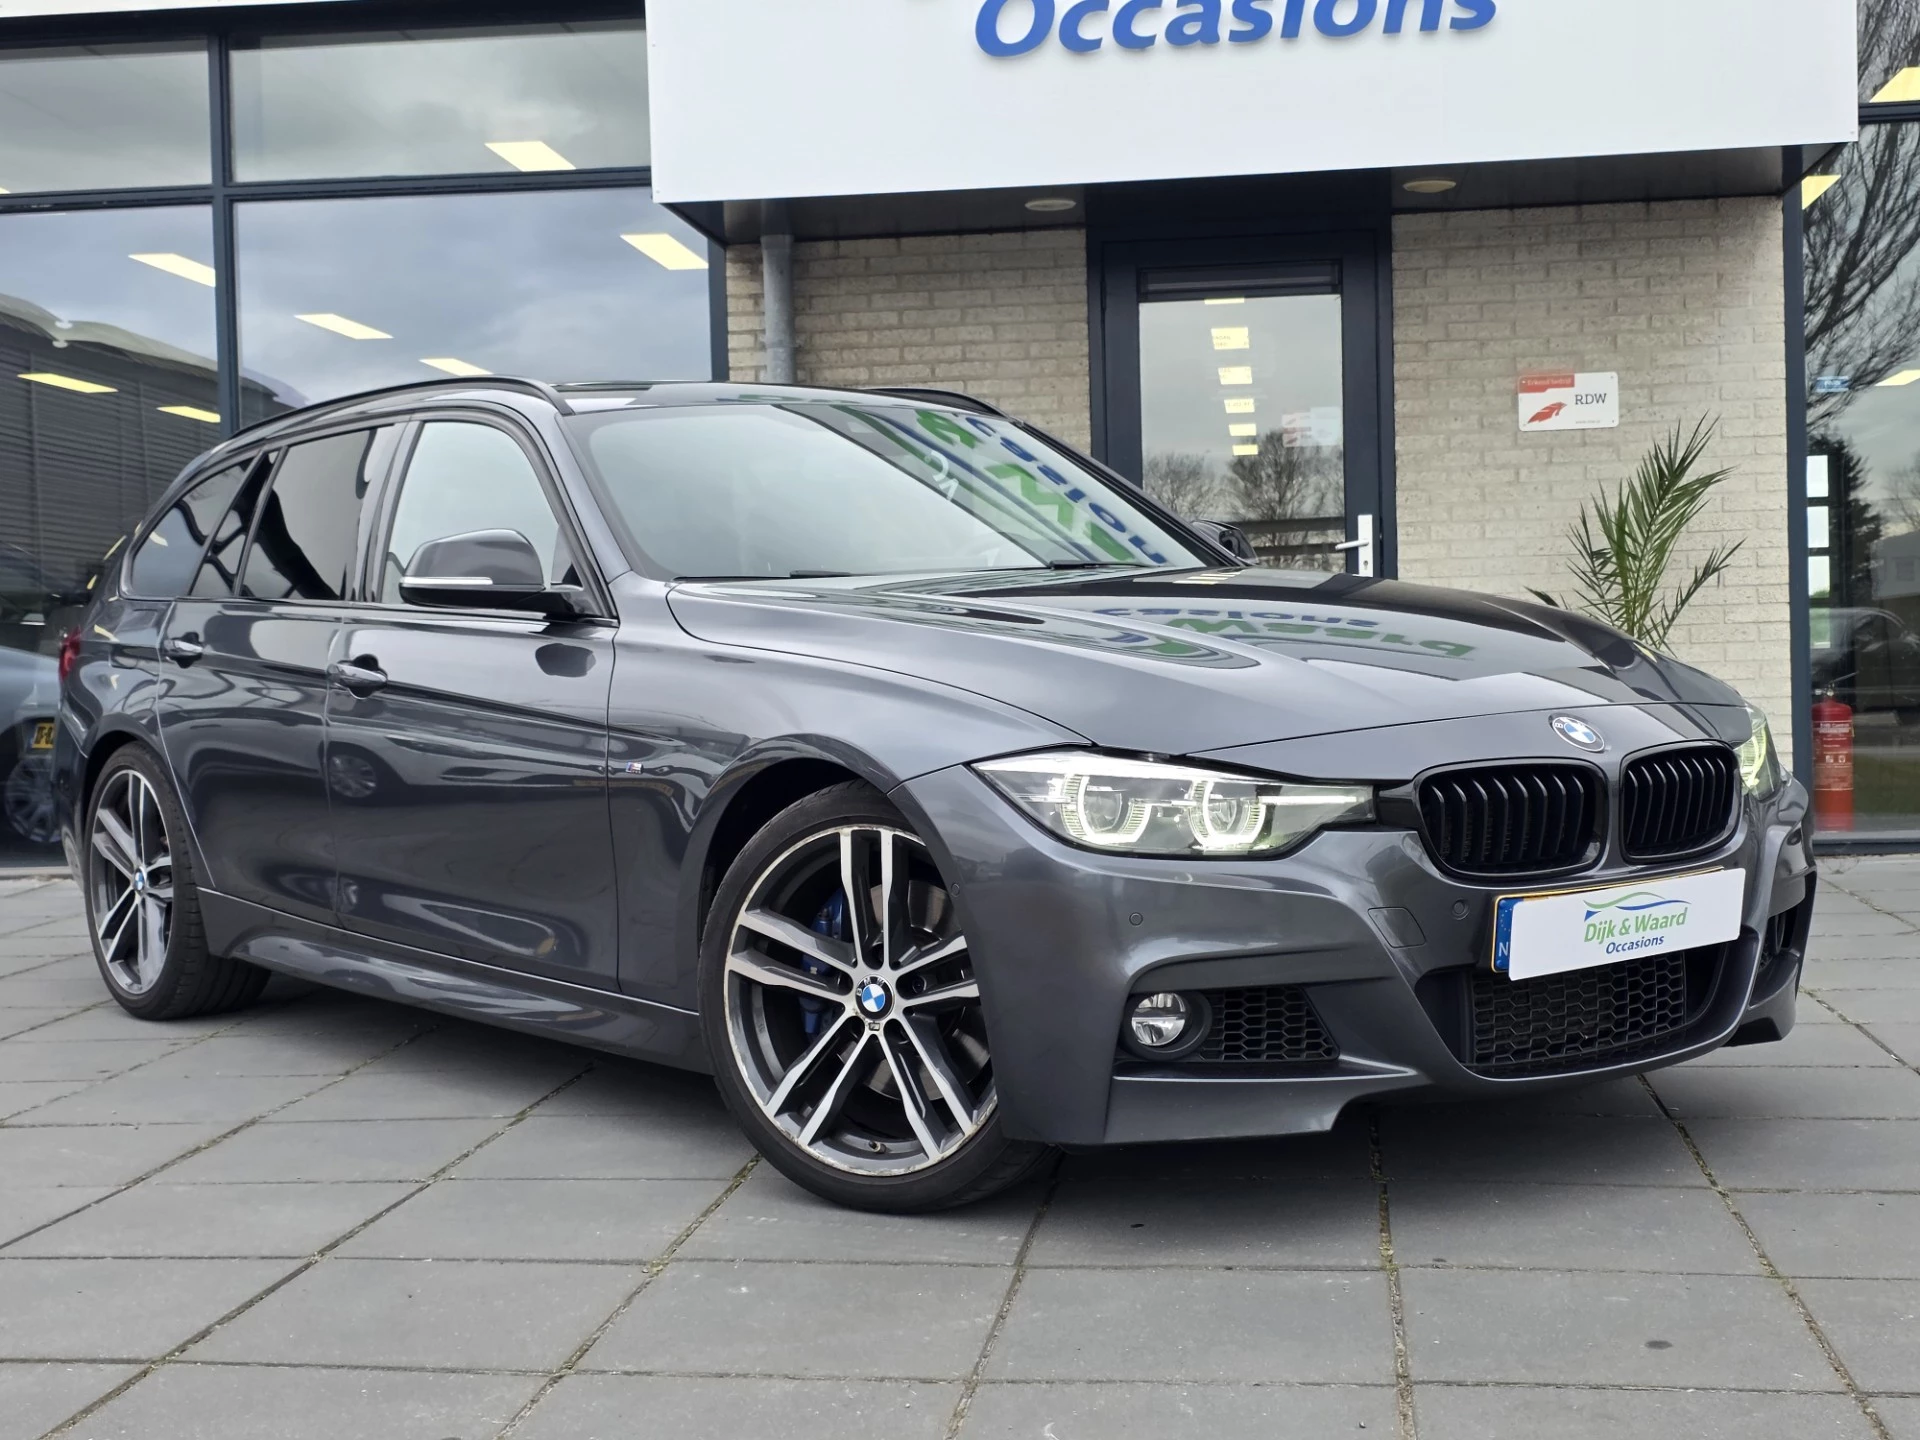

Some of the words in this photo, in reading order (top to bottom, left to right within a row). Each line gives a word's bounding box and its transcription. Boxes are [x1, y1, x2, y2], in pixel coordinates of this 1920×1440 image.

[1574, 393, 1607, 406] RDW
[1584, 922, 1616, 945] Dijk
[1619, 918, 1633, 936] &
[1635, 907, 1688, 933] Waard
[1605, 935, 1665, 955] Occasions
